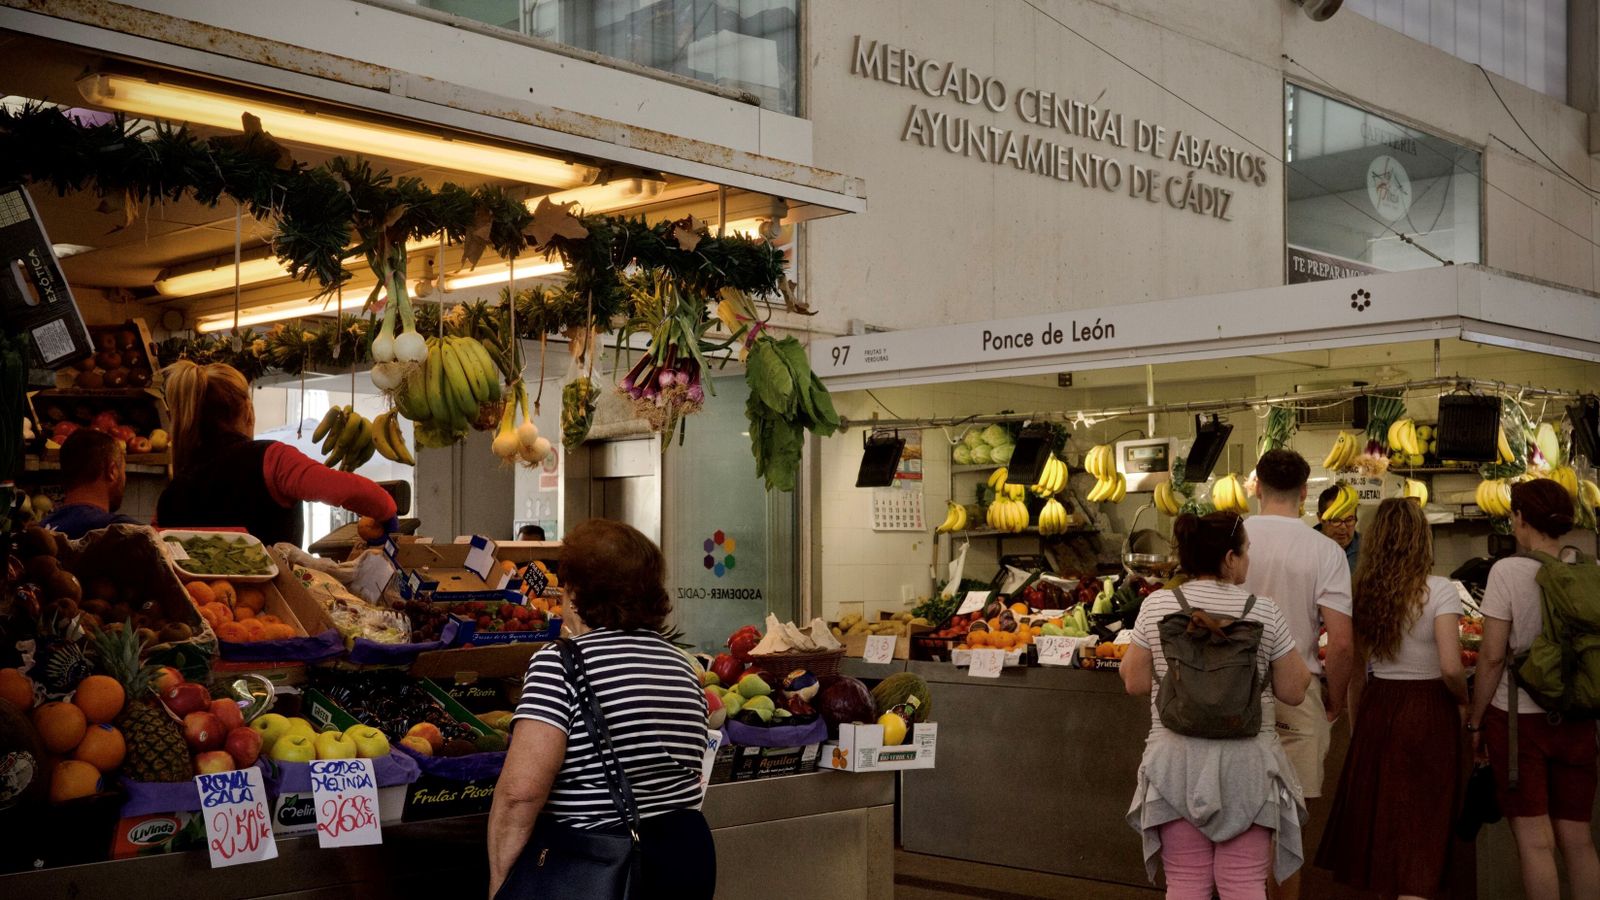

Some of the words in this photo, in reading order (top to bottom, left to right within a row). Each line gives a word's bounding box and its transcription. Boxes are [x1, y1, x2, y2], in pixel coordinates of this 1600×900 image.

[851, 35, 1008, 113] MERCADO
[1016, 87, 1127, 148] CENTRAL
[1134, 119, 1165, 158] DE
[1169, 129, 1267, 187] ABASTOS
[901, 104, 1121, 193] AYUNTAMIENTO
[1129, 164, 1159, 203] DE
[1165, 170, 1234, 220] CÁDIZ
[28, 248, 57, 304] EXÓTICA
[1293, 256, 1306, 273] TE
[982, 330, 1033, 351] Ponce
[1041, 323, 1063, 345] de
[1072, 318, 1115, 342] León
[831, 346, 850, 366] 97
[412, 788, 459, 805] Frutas
